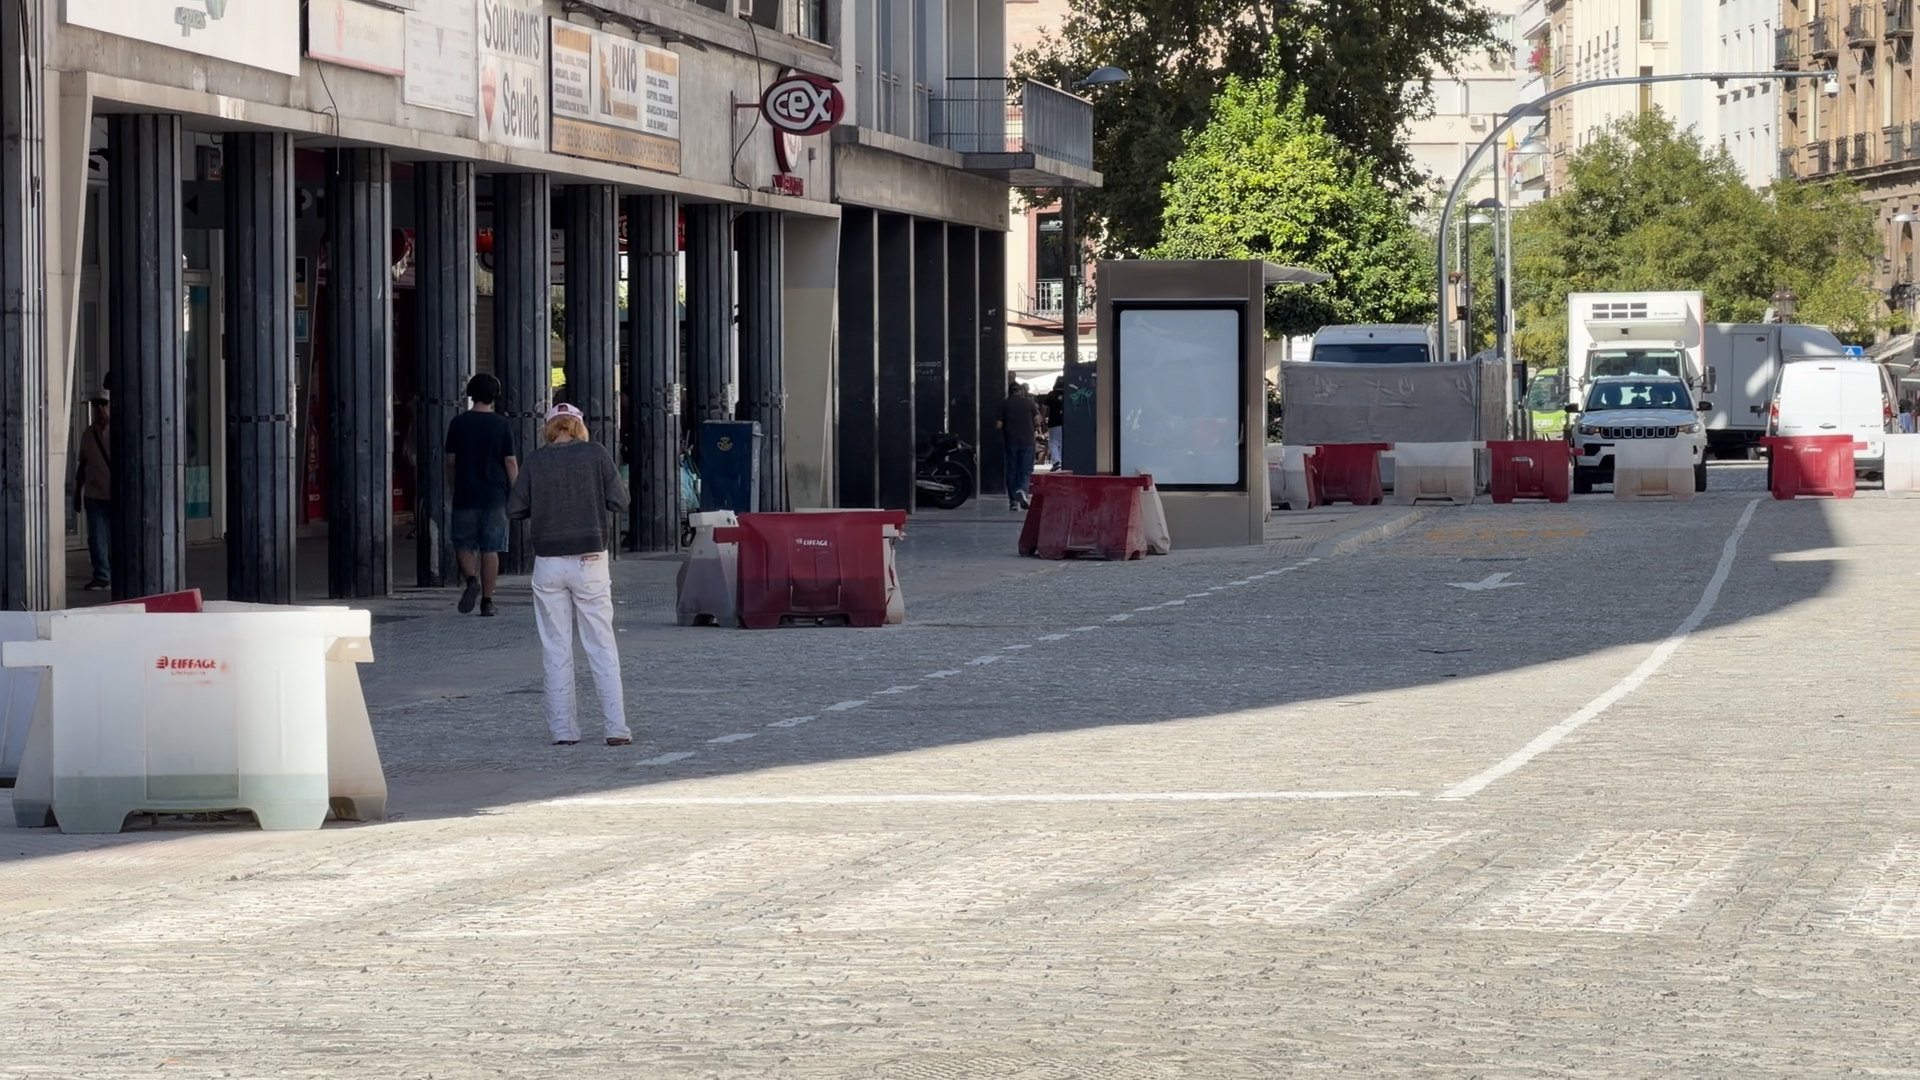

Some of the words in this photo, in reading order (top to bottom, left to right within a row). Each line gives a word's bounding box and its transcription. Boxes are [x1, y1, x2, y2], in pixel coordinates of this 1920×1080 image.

[484, 0, 540, 60] Souvenirs
[611, 43, 637, 93] PINO
[502, 72, 540, 141] Sevilla
[1007, 351, 1037, 362] FFEE
[1040, 351, 1065, 362] CAK
[171, 658, 216, 669] EIFFAGE
